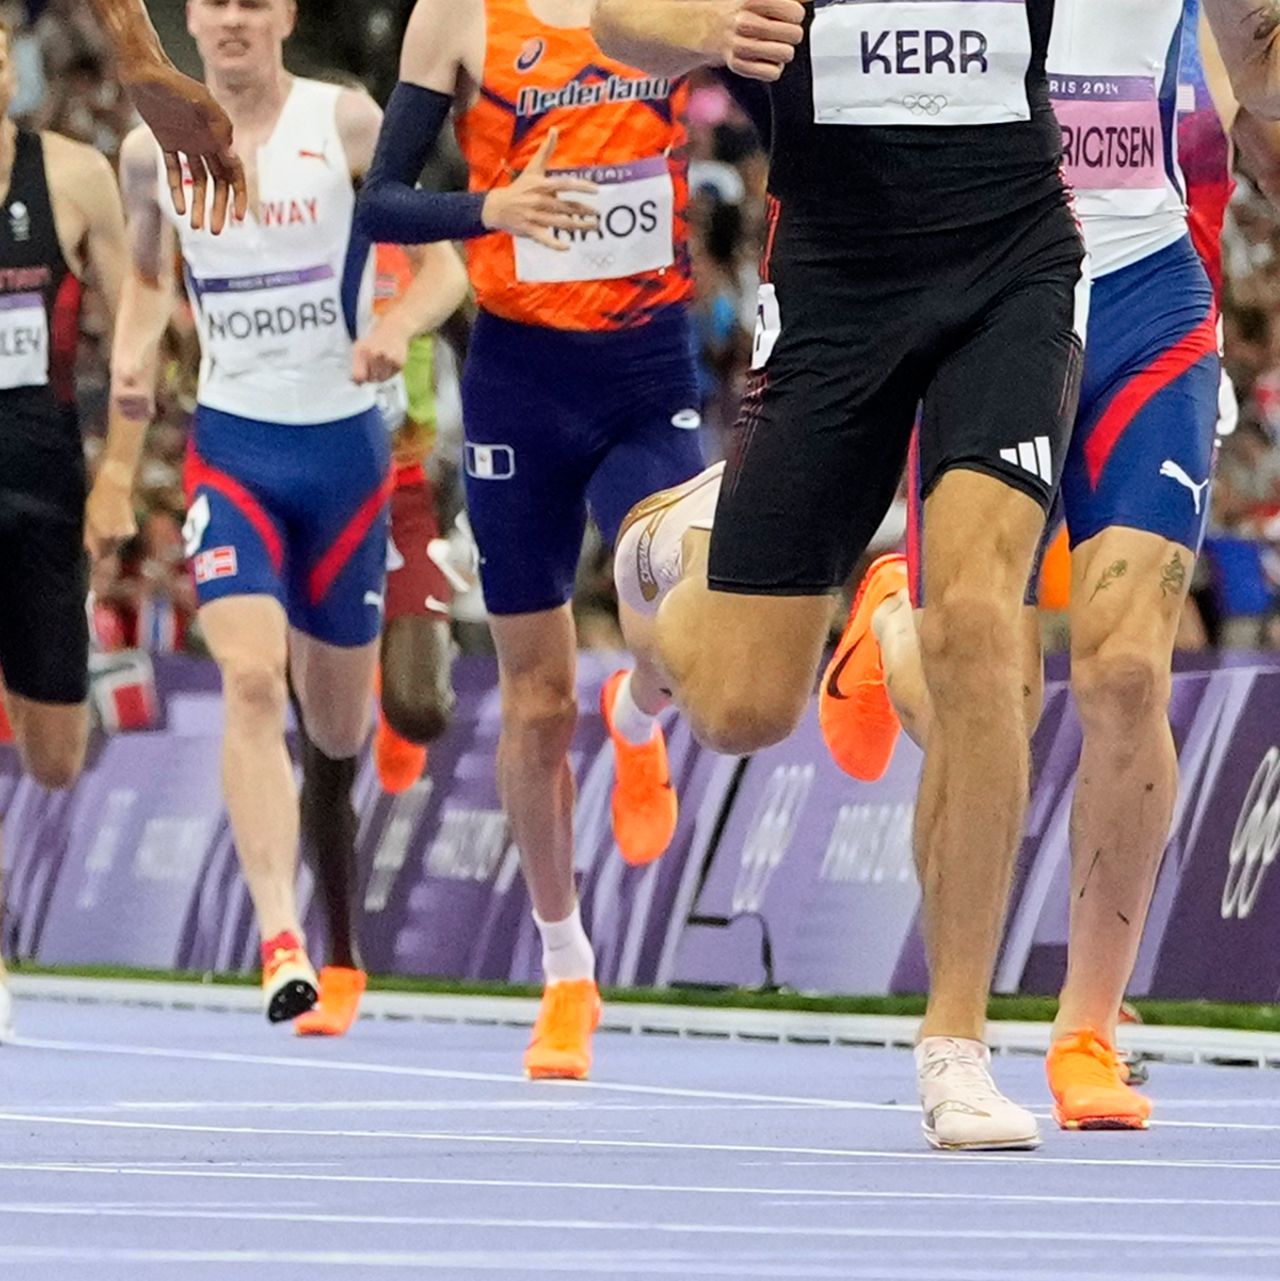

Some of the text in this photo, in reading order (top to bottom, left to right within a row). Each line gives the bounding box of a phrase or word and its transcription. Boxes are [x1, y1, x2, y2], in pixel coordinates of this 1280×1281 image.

[860, 30, 989, 75] KERR
[1048, 81, 1077, 94] RIS
[208, 298, 338, 340] NORDAS
